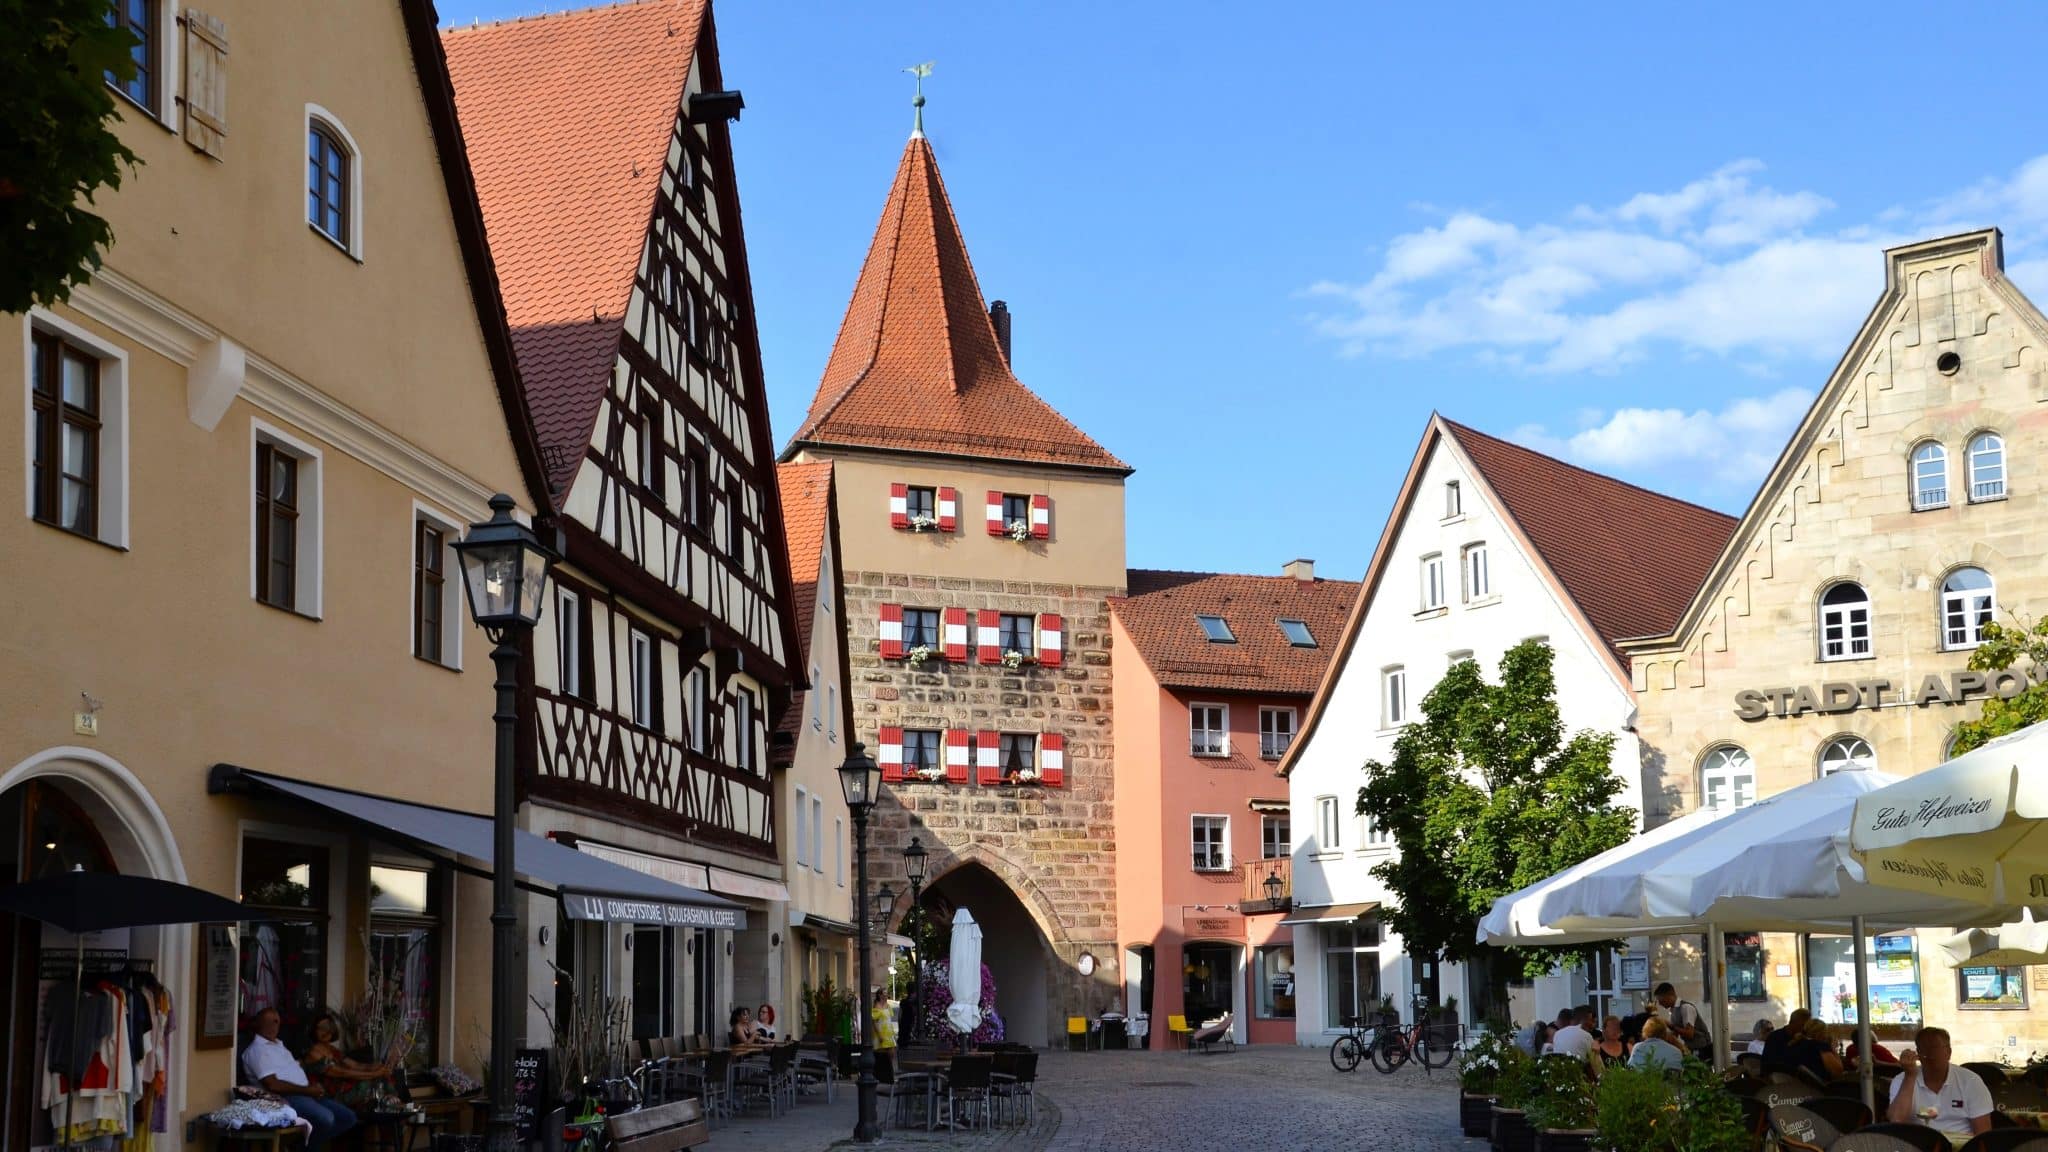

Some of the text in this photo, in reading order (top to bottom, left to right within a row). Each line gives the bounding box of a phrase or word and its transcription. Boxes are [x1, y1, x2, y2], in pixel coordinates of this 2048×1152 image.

[1733, 678, 1890, 719] STADT
[1871, 795, 1993, 832] Gutes Hefeweizen
[607, 900, 662, 921] CONCEPTSTORE
[668, 903, 710, 924] SOULFASHION
[715, 910, 736, 926] COFFEE
